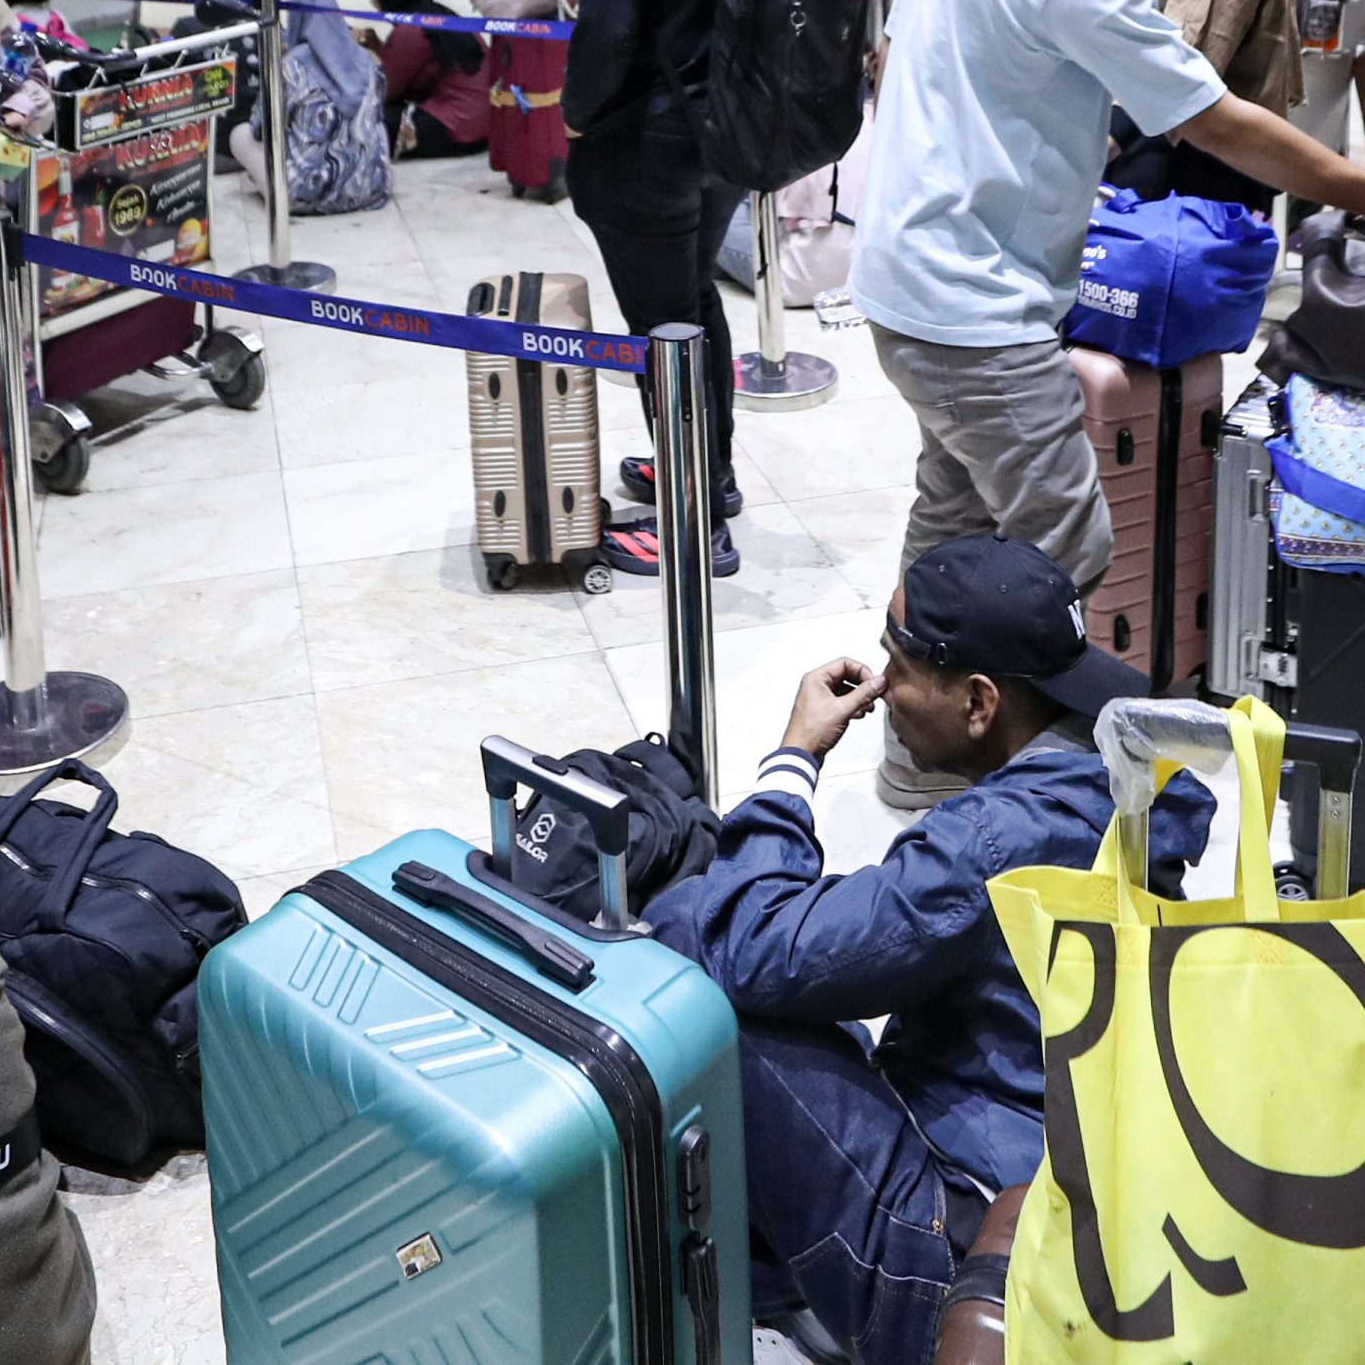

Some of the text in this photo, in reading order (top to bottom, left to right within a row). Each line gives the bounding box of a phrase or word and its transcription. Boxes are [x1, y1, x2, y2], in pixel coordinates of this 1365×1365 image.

[485, 20, 551, 34] BOOKCABIN
[113, 207, 142, 226] 1969
[1078, 278, 1140, 309] 1500-366
[129, 264, 643, 365] BOOKCABIN BOOKCABIN BOOKCABI
